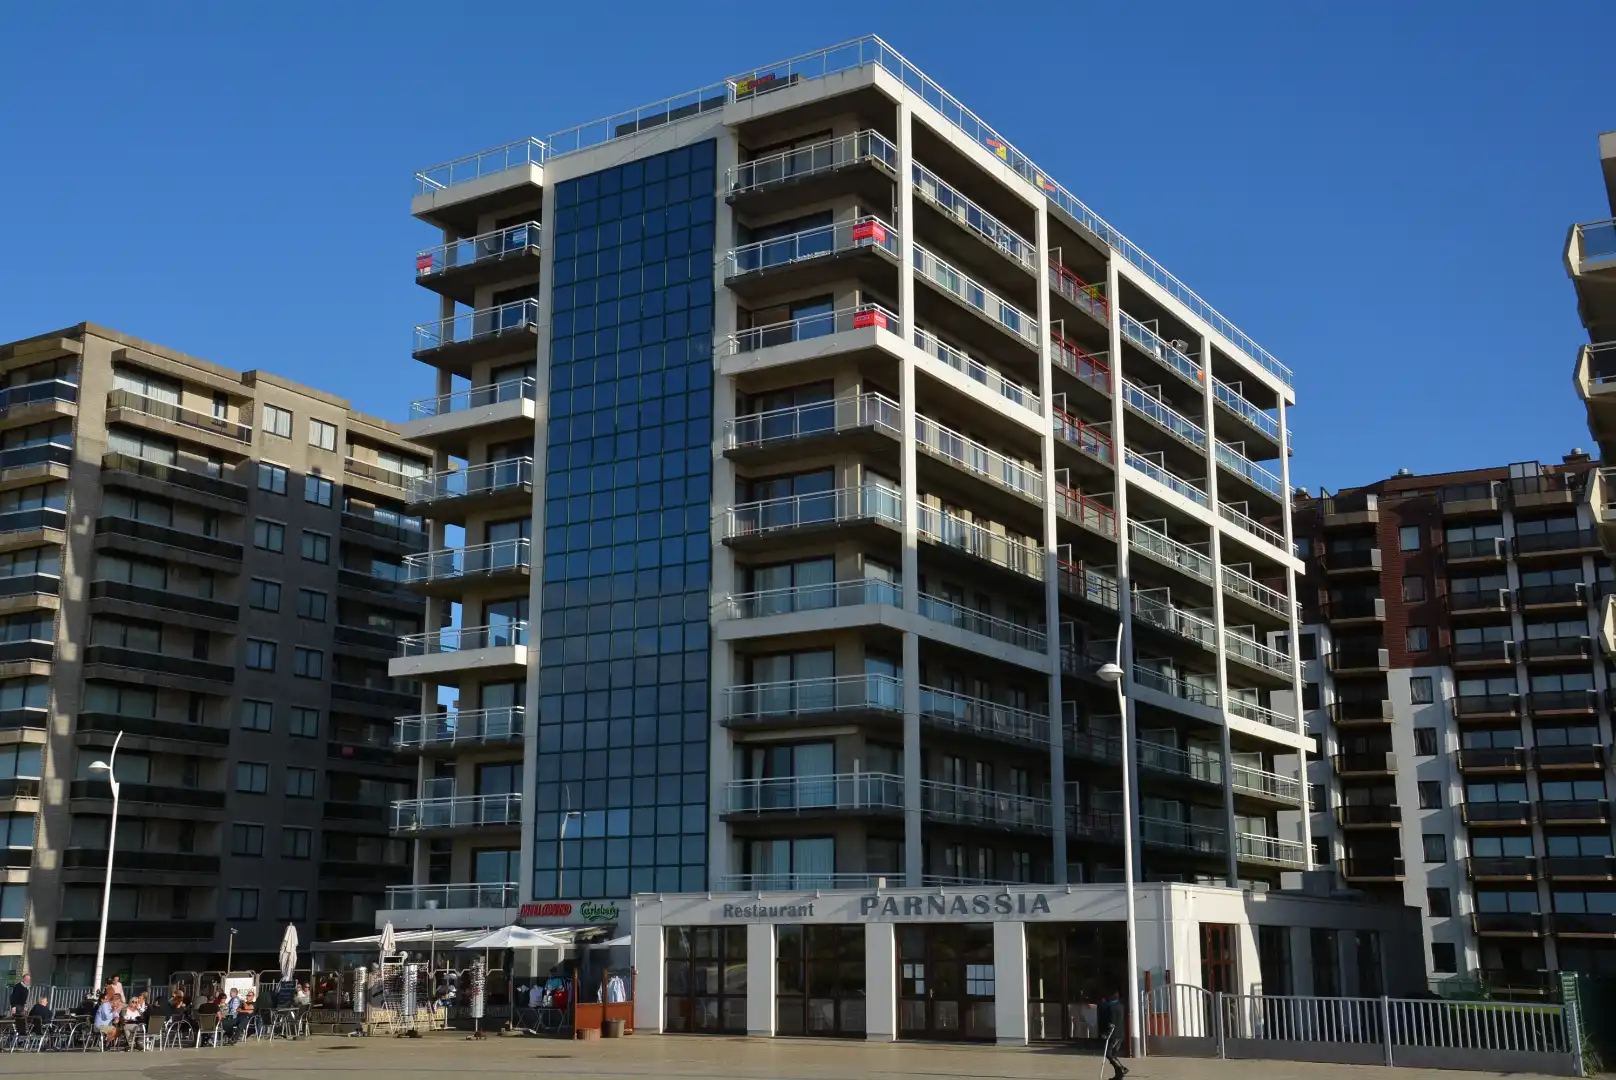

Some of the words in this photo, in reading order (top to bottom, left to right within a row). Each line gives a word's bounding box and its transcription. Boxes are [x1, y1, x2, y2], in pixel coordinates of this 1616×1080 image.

[581, 901, 620, 921] Carlsberg
[723, 903, 814, 918] Restaurant
[860, 893, 1051, 916] PARNASSIA
